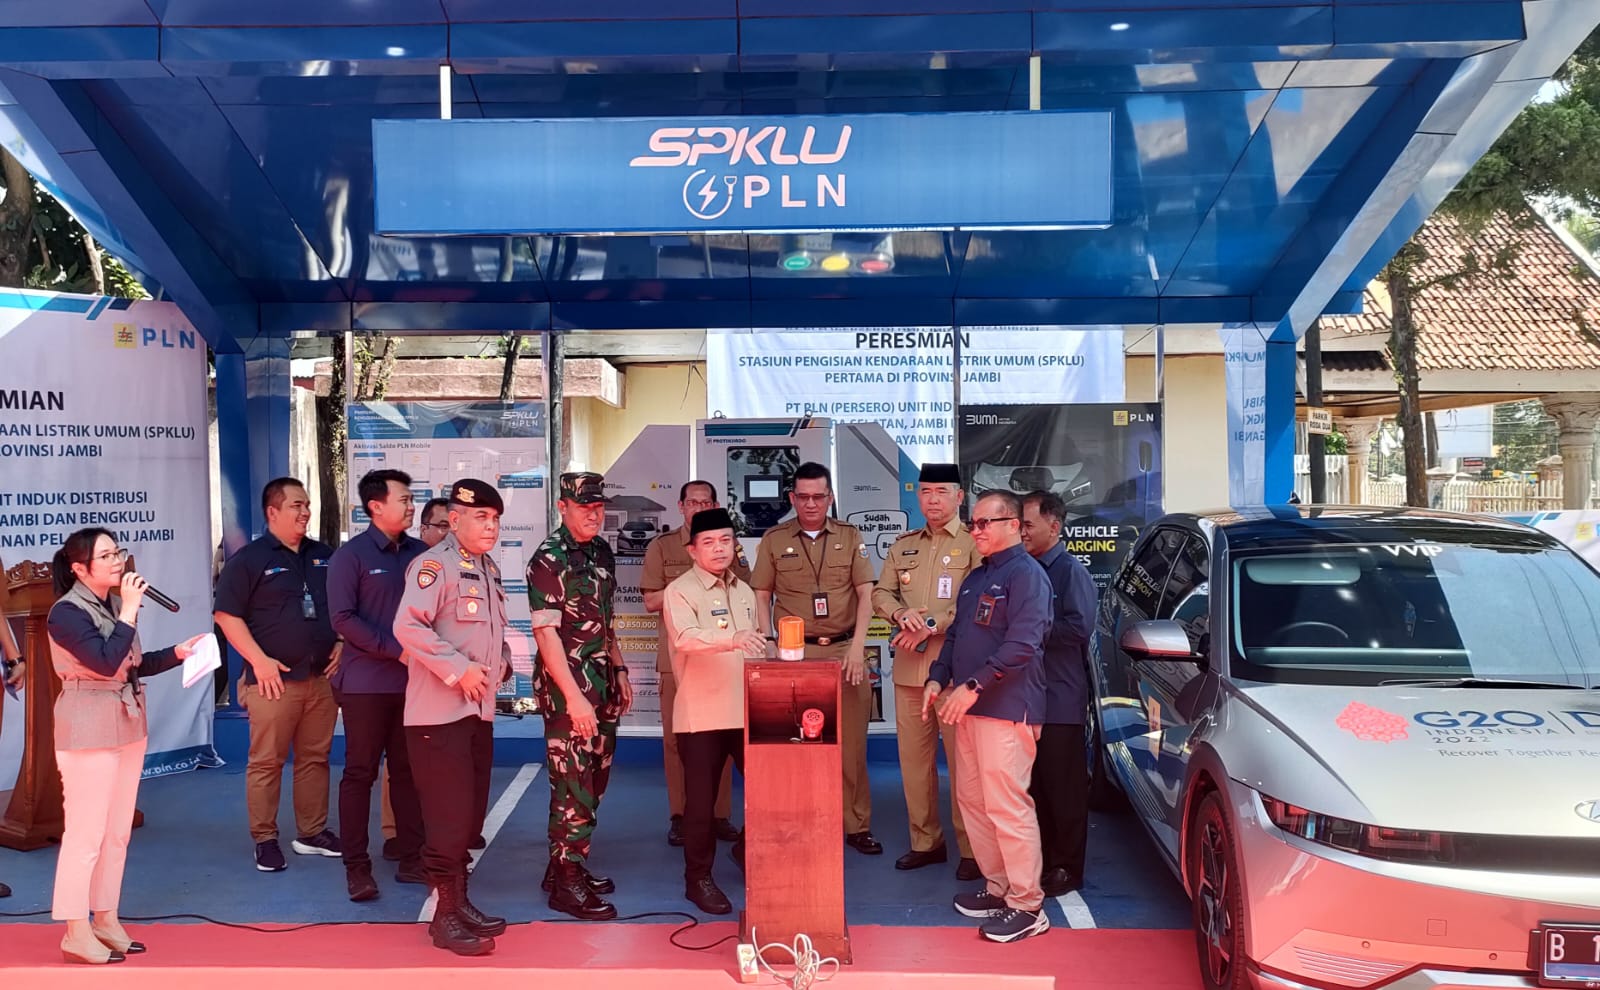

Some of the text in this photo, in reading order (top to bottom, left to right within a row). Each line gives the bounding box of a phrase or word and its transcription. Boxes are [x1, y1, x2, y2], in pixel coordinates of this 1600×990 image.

[629, 125, 852, 167] SPKLU
[743, 173, 847, 208] PLN
[142, 327, 196, 349] PLN
[856, 332, 970, 349] PERESMIAN
[739, 355, 1085, 367] STASIUN PENGISIAN KENDARAAN LSTRIK UMUM (SPKLU)
[825, 372, 1001, 383] PERTAMA DI PROVINS JAMBI
[785, 403, 800, 413] PT
[804, 403, 827, 413] PLN
[831, 402, 895, 414] (PERSERO)
[898, 402, 925, 412] UNIT
[1130, 413, 1154, 421] PLN
[910, 418, 947, 429] JAMBI
[35, 424, 90, 437] LISTRIK
[94, 425, 140, 437] UMUM
[144, 426, 195, 440] (SPKLU)
[0, 444, 102, 457] OVINSI JAMBI
[17, 492, 66, 506] INDUK
[70, 491, 147, 504] DISTRIBUSI
[43, 512, 76, 526] DAN
[80, 510, 155, 524] BENGKULU
[864, 513, 890, 522] Sudah
[858, 524, 902, 532] khir Bulan
[1064, 526, 1119, 538] VEHICLE
[132, 529, 174, 542] JAMBI
[1064, 540, 1116, 552] ARGING
[1381, 545, 1443, 557] VVIP
[1413, 710, 1545, 728] G20
[1425, 728, 1560, 736] INDONESIA
[1432, 736, 1491, 744] 2022
[1438, 748, 1500, 757] Recover
[1504, 748, 1573, 759] Together
[1550, 933, 1565, 961] B
